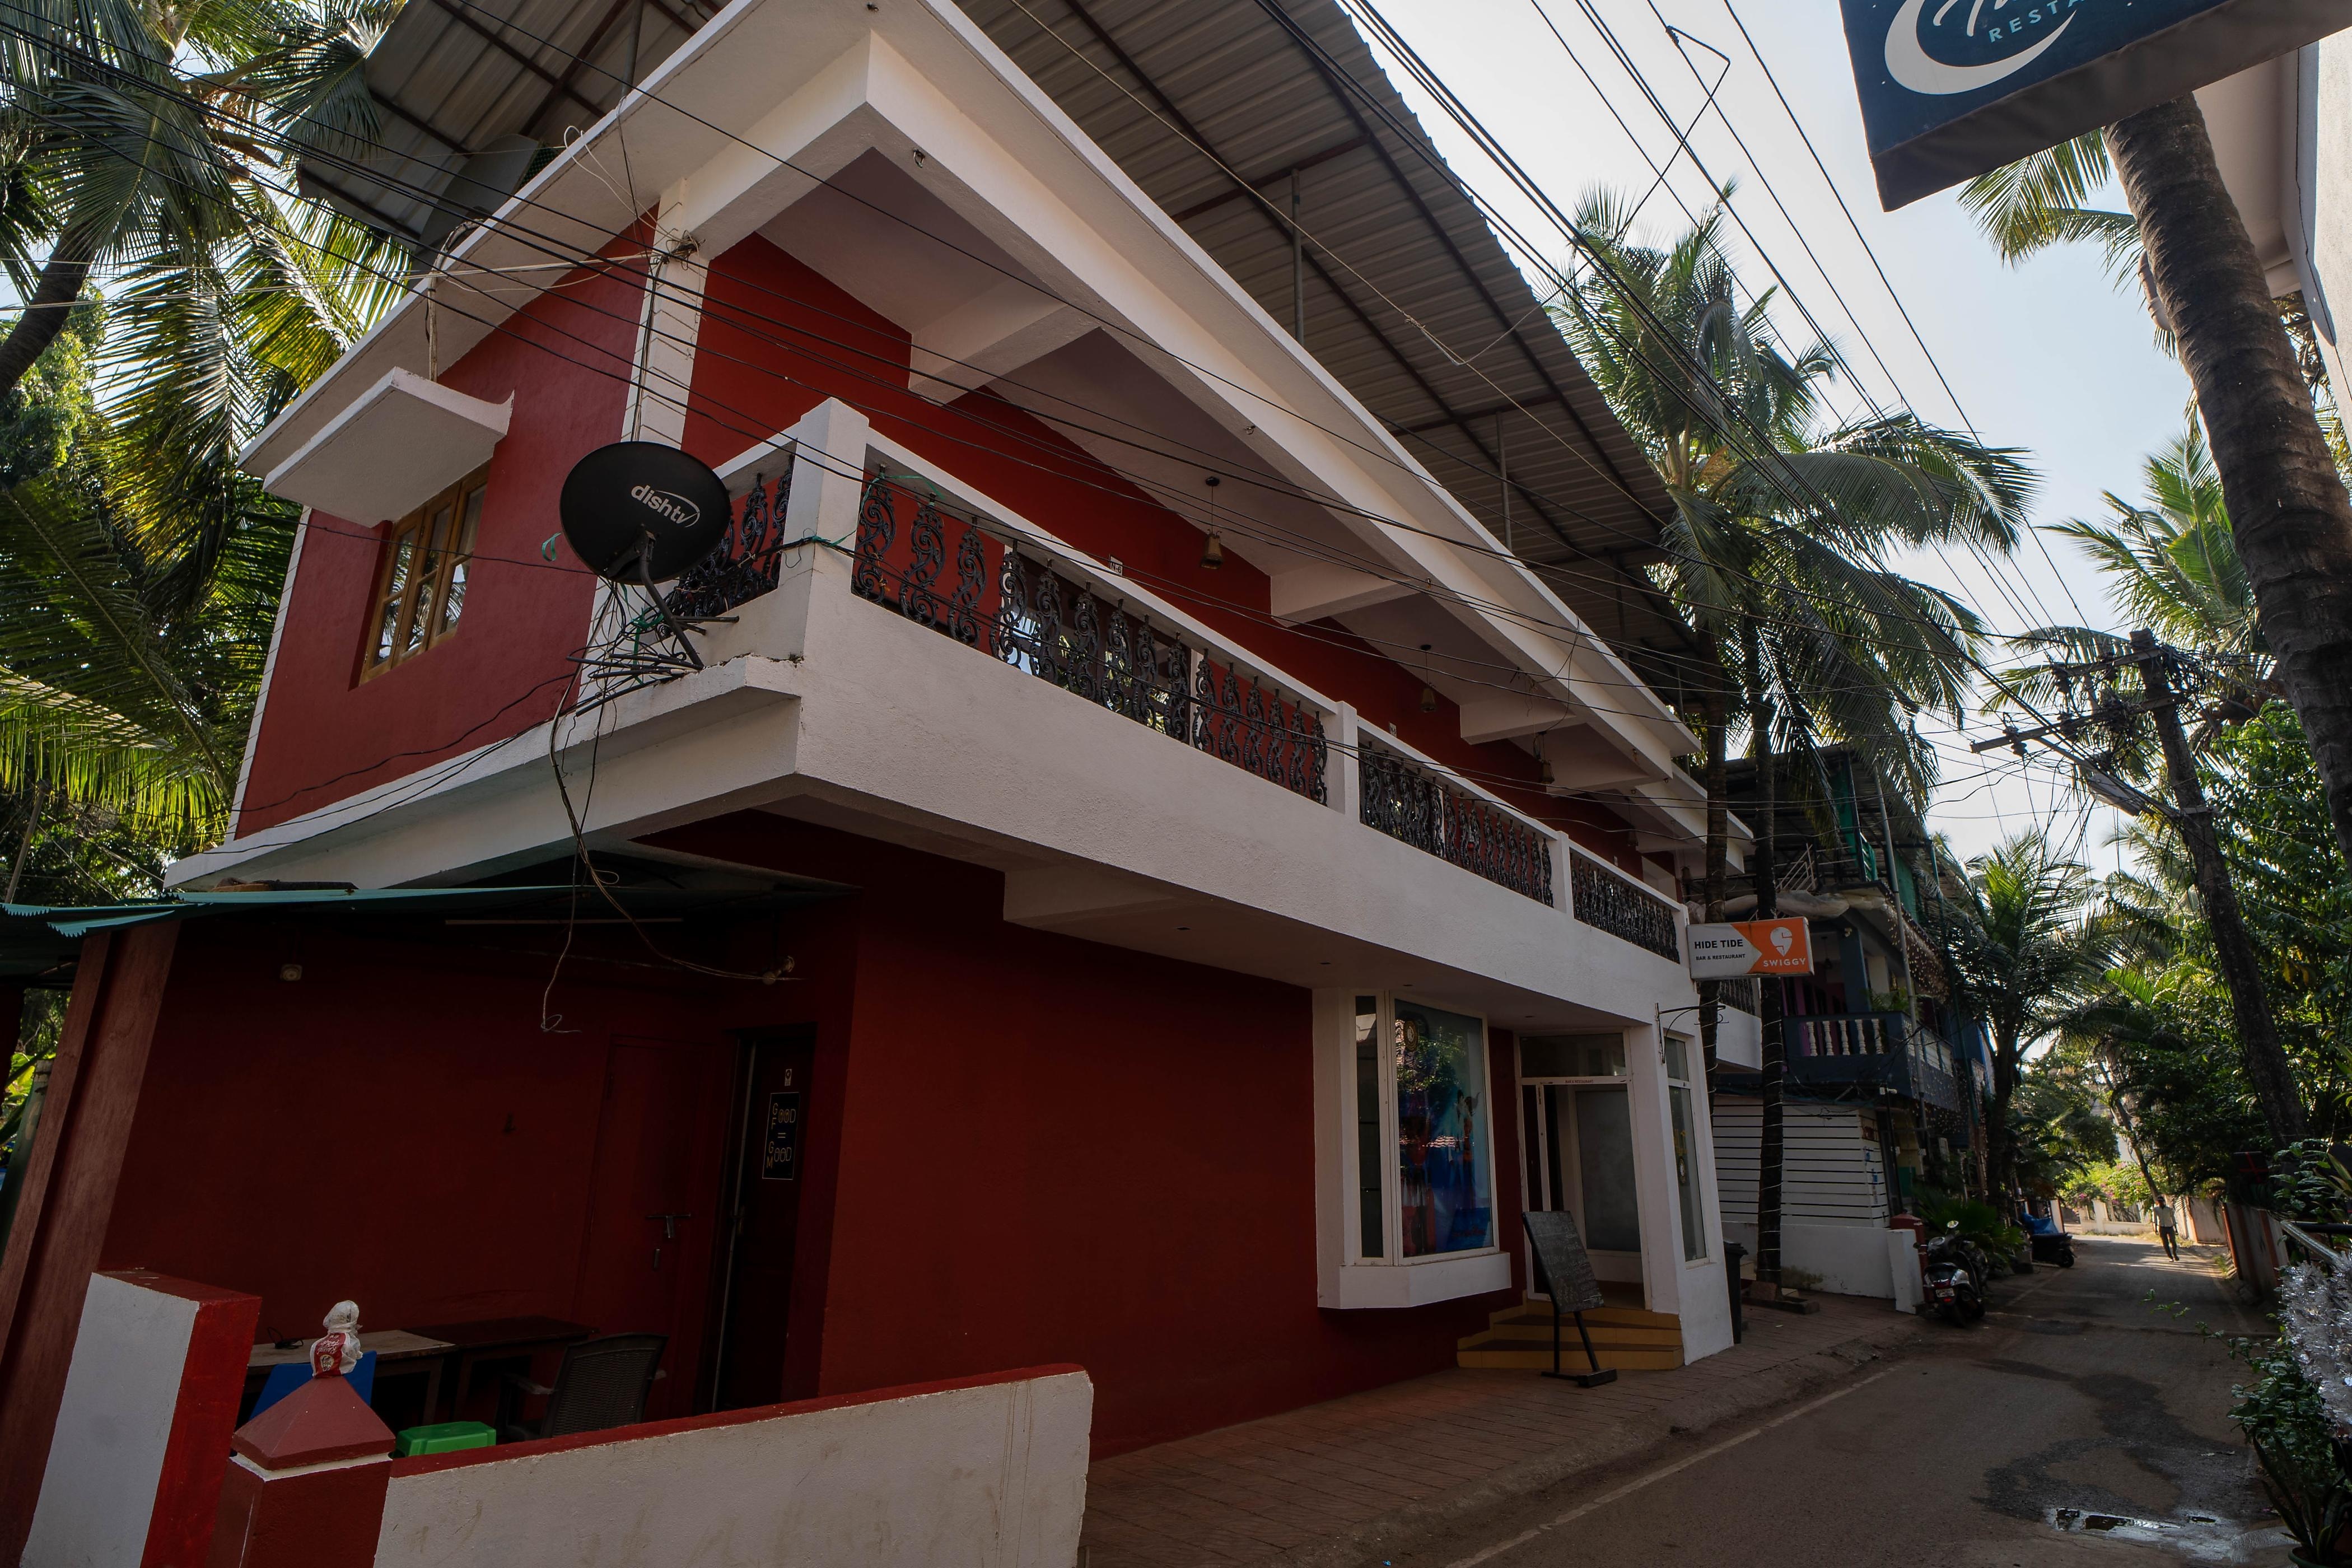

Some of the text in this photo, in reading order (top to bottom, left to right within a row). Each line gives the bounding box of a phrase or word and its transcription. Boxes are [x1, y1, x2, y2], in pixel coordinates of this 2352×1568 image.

[631, 484, 698, 524] dishtv
[1694, 939, 1743, 949] HIDE TIDE
[1763, 958, 1806, 967] SWIGGY
